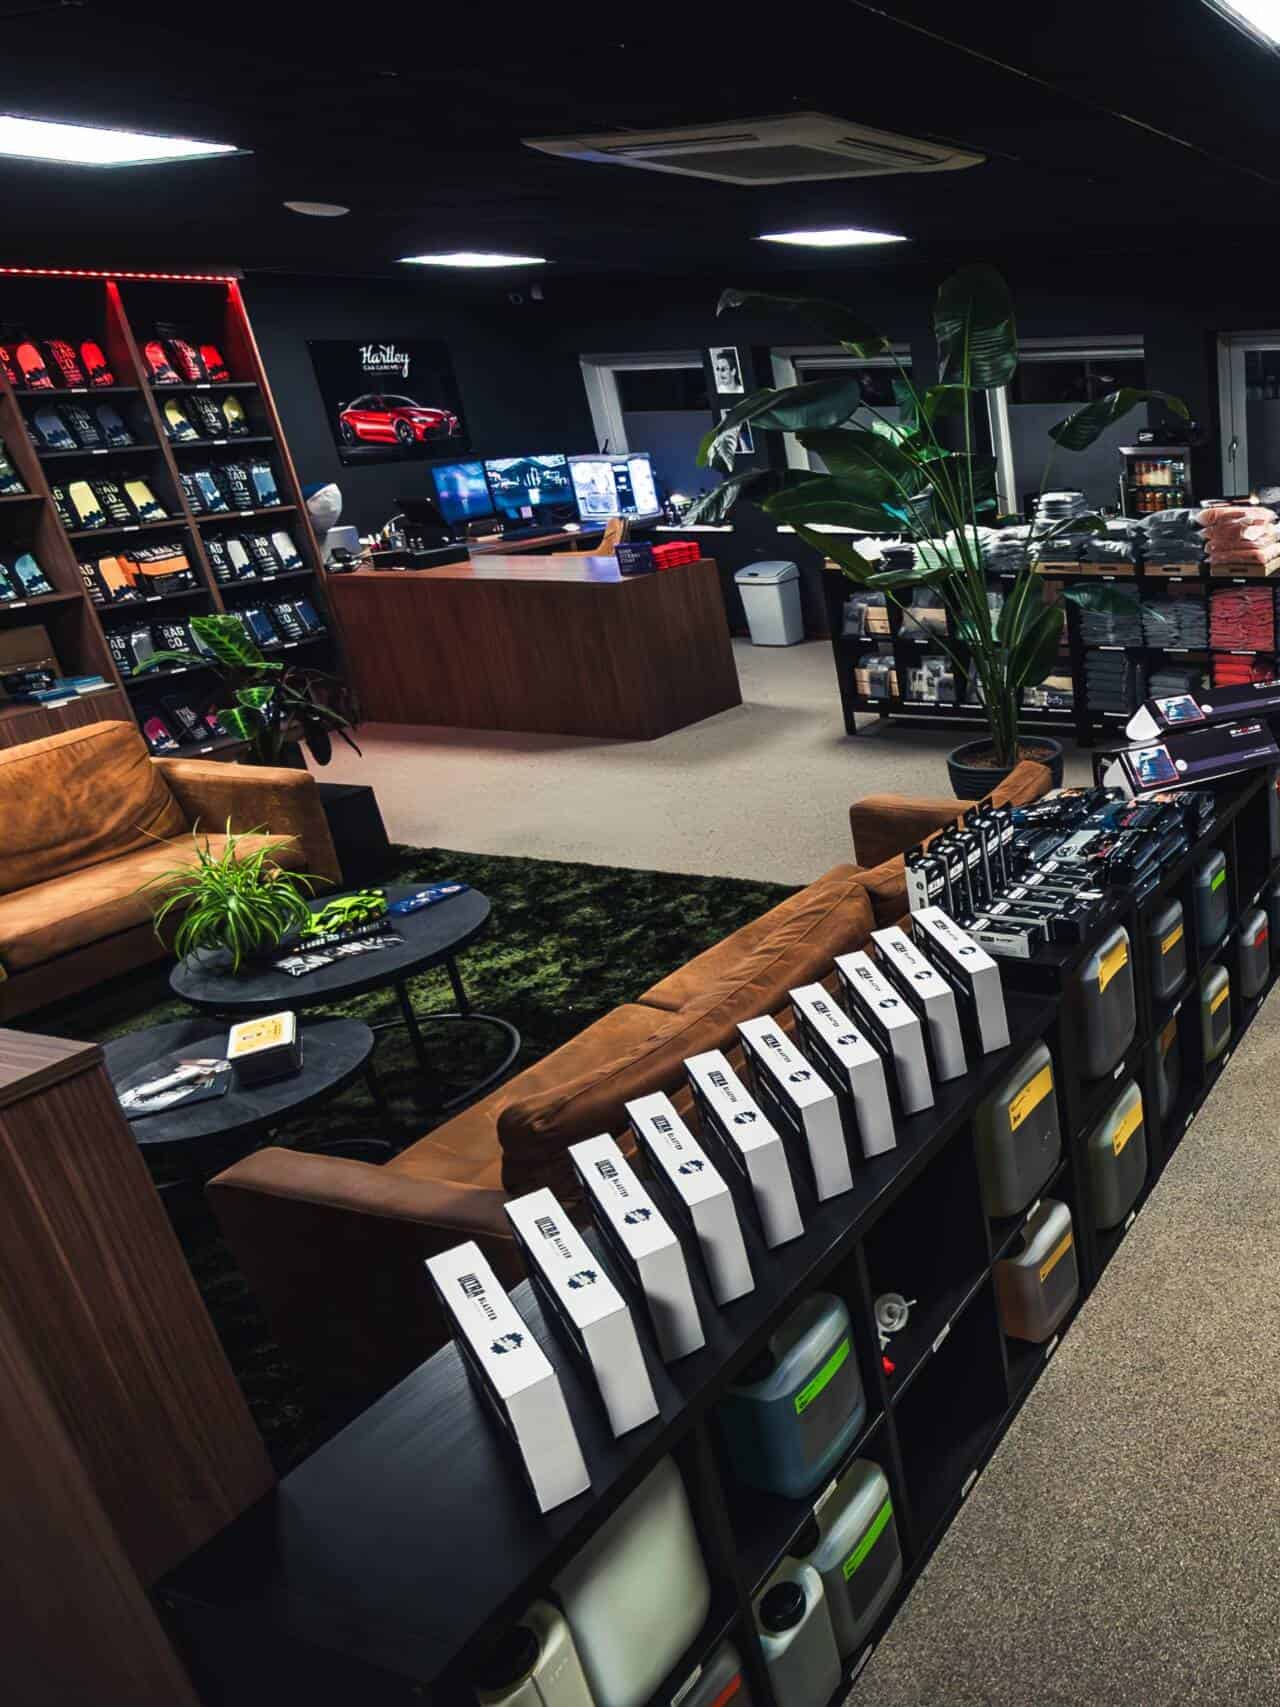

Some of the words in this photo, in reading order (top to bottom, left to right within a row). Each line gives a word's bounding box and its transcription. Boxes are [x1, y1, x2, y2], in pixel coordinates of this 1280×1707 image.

[359, 344, 411, 378] Hartley
[161, 626, 186, 640] RAG
[457, 1273, 485, 1299] ULTRA
